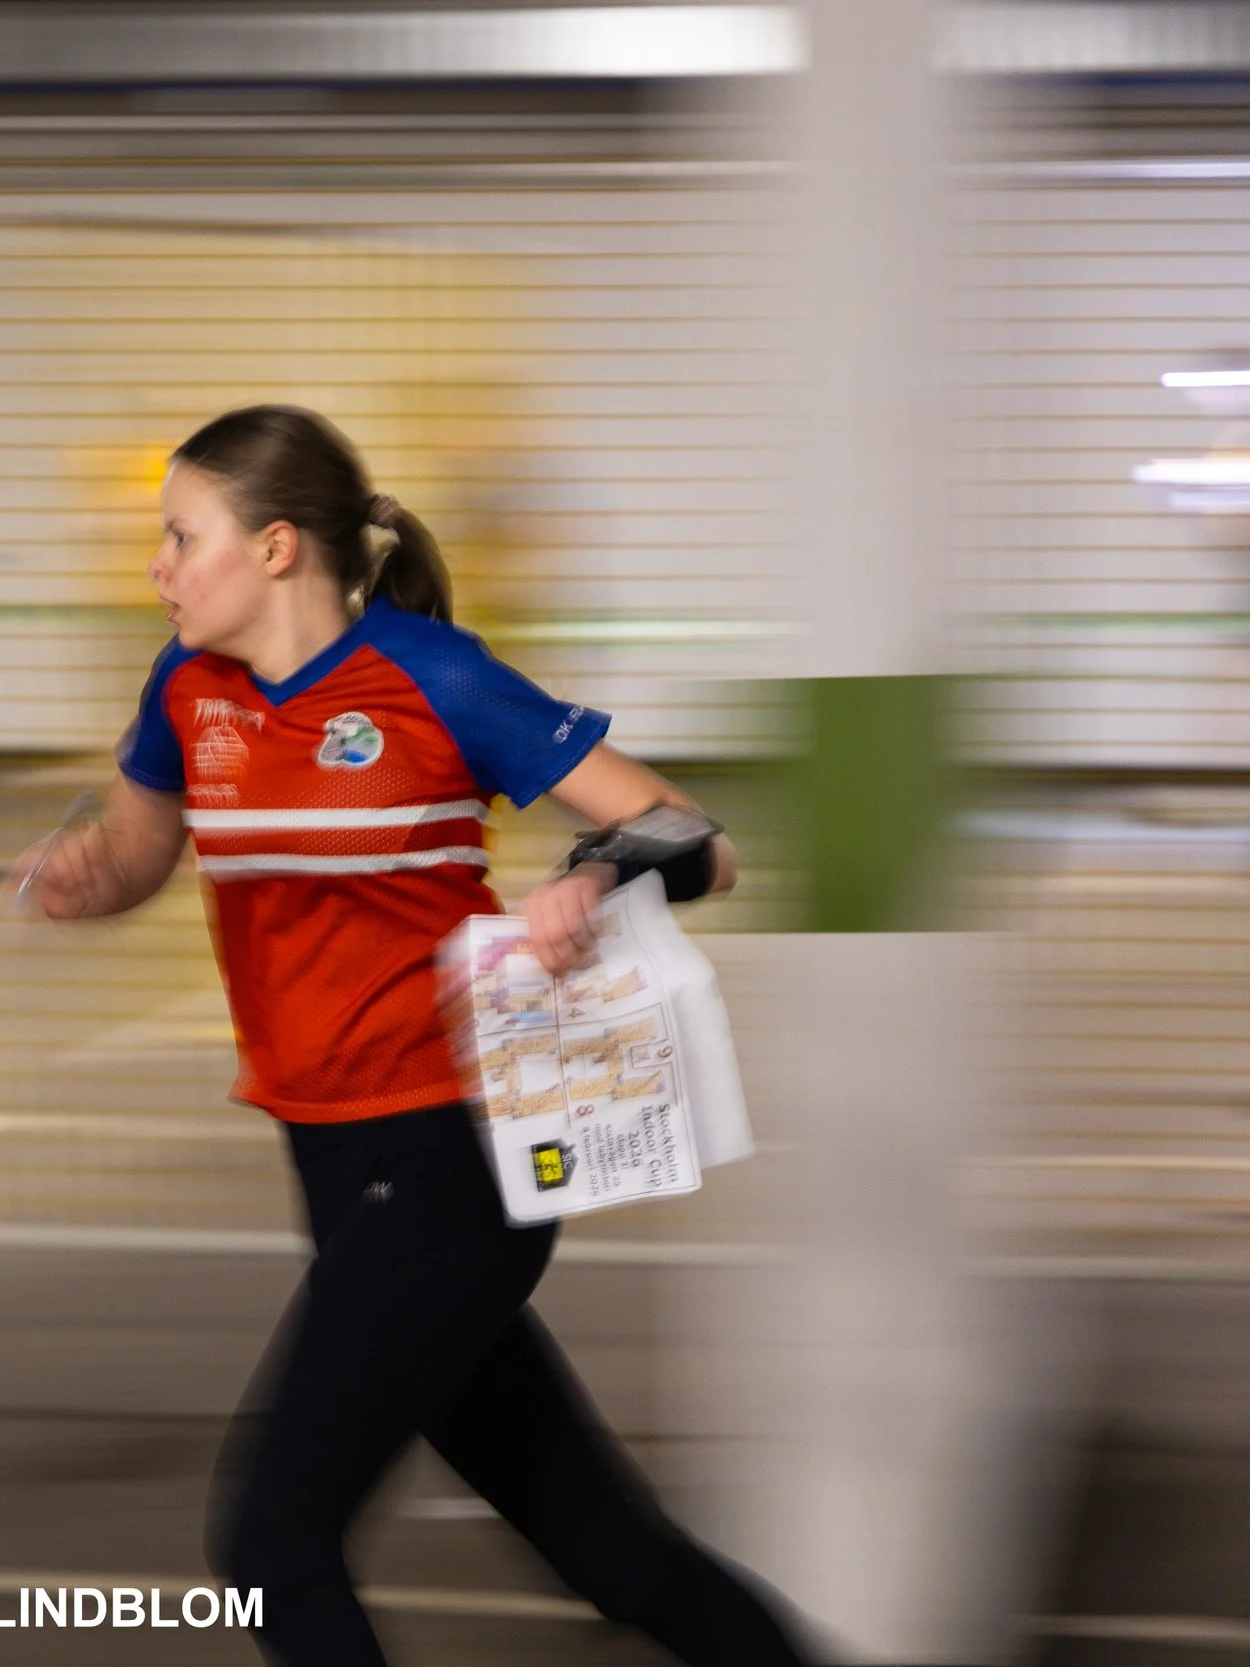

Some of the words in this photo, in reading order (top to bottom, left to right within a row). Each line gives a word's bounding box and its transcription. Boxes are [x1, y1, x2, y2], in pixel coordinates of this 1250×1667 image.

[657, 1045, 673, 1059] 9
[576, 1105, 594, 1117] 8
[641, 1105, 661, 1153] Indoor
[657, 1103, 682, 1182] Stockholm
[627, 1130, 644, 1167] 2026
[644, 1158, 666, 1188] Cup
